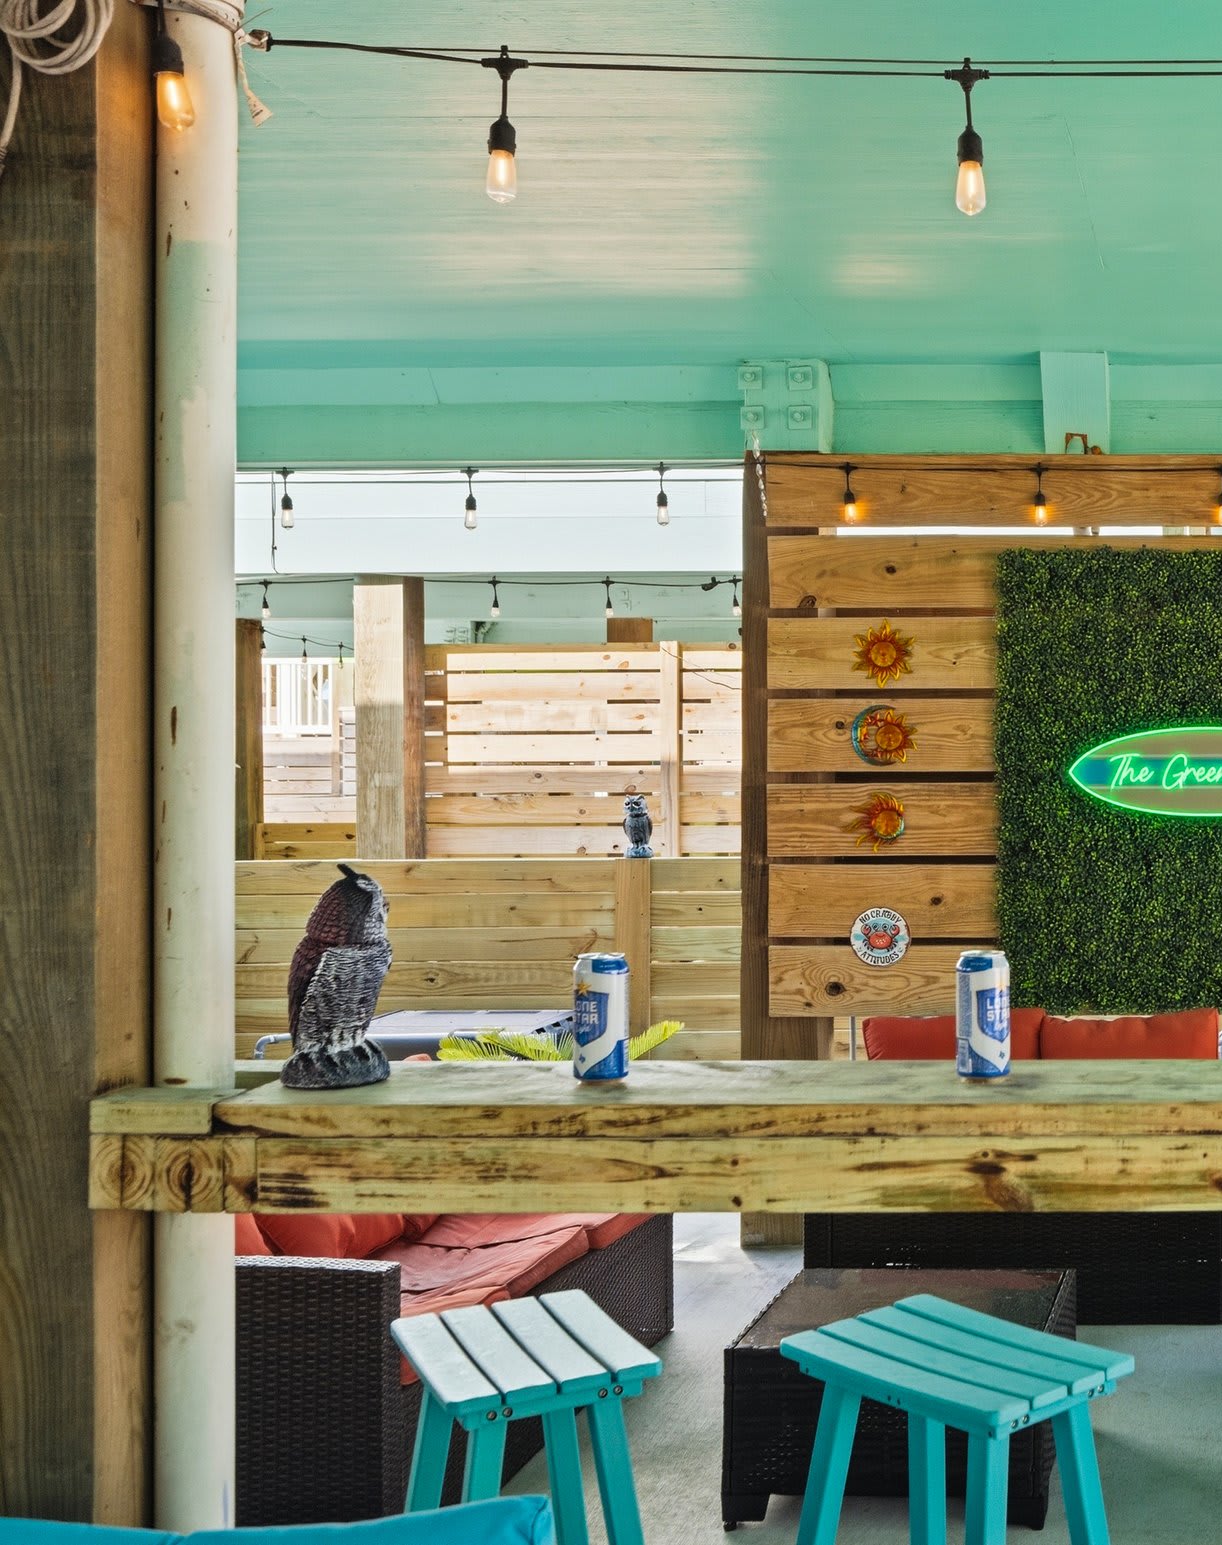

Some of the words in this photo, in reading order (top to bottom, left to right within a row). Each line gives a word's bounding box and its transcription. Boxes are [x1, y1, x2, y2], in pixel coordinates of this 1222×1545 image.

[1109, 752, 1155, 791] The
[858, 913, 871, 924] NO
[870, 909, 902, 924] CRABBY
[860, 951, 900, 965] ATTITUDES
[575, 1001, 598, 1012] ONE
[574, 1013, 599, 1024] TAR
